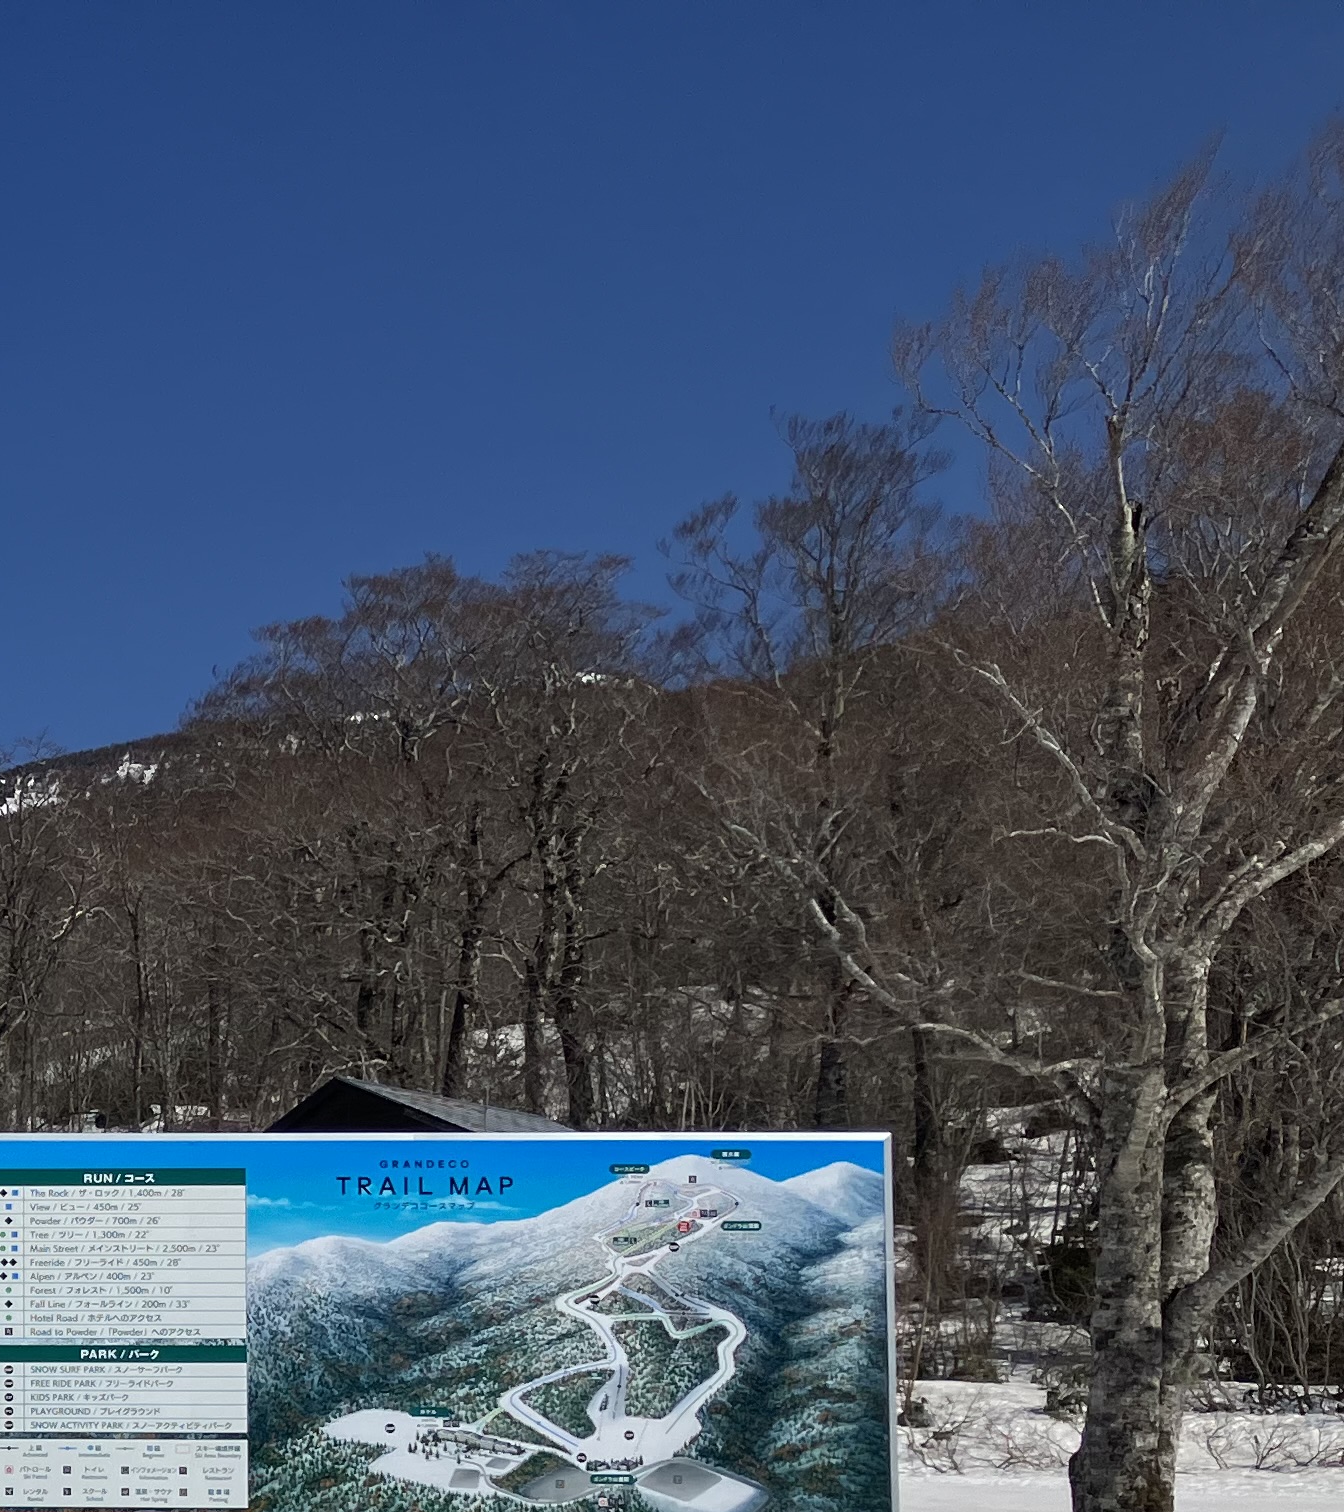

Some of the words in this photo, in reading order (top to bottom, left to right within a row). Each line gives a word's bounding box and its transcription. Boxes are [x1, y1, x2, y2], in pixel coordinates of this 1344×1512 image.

[380, 1160, 470, 1169] GRANDECO
[84, 1174, 113, 1184] RUN
[125, 1174, 155, 1184] コース
[336, 1177, 432, 1195] TRAIL
[450, 1177, 514, 1195] MAP
[81, 1350, 117, 1359] PARK
[129, 1350, 160, 1359] パーク
